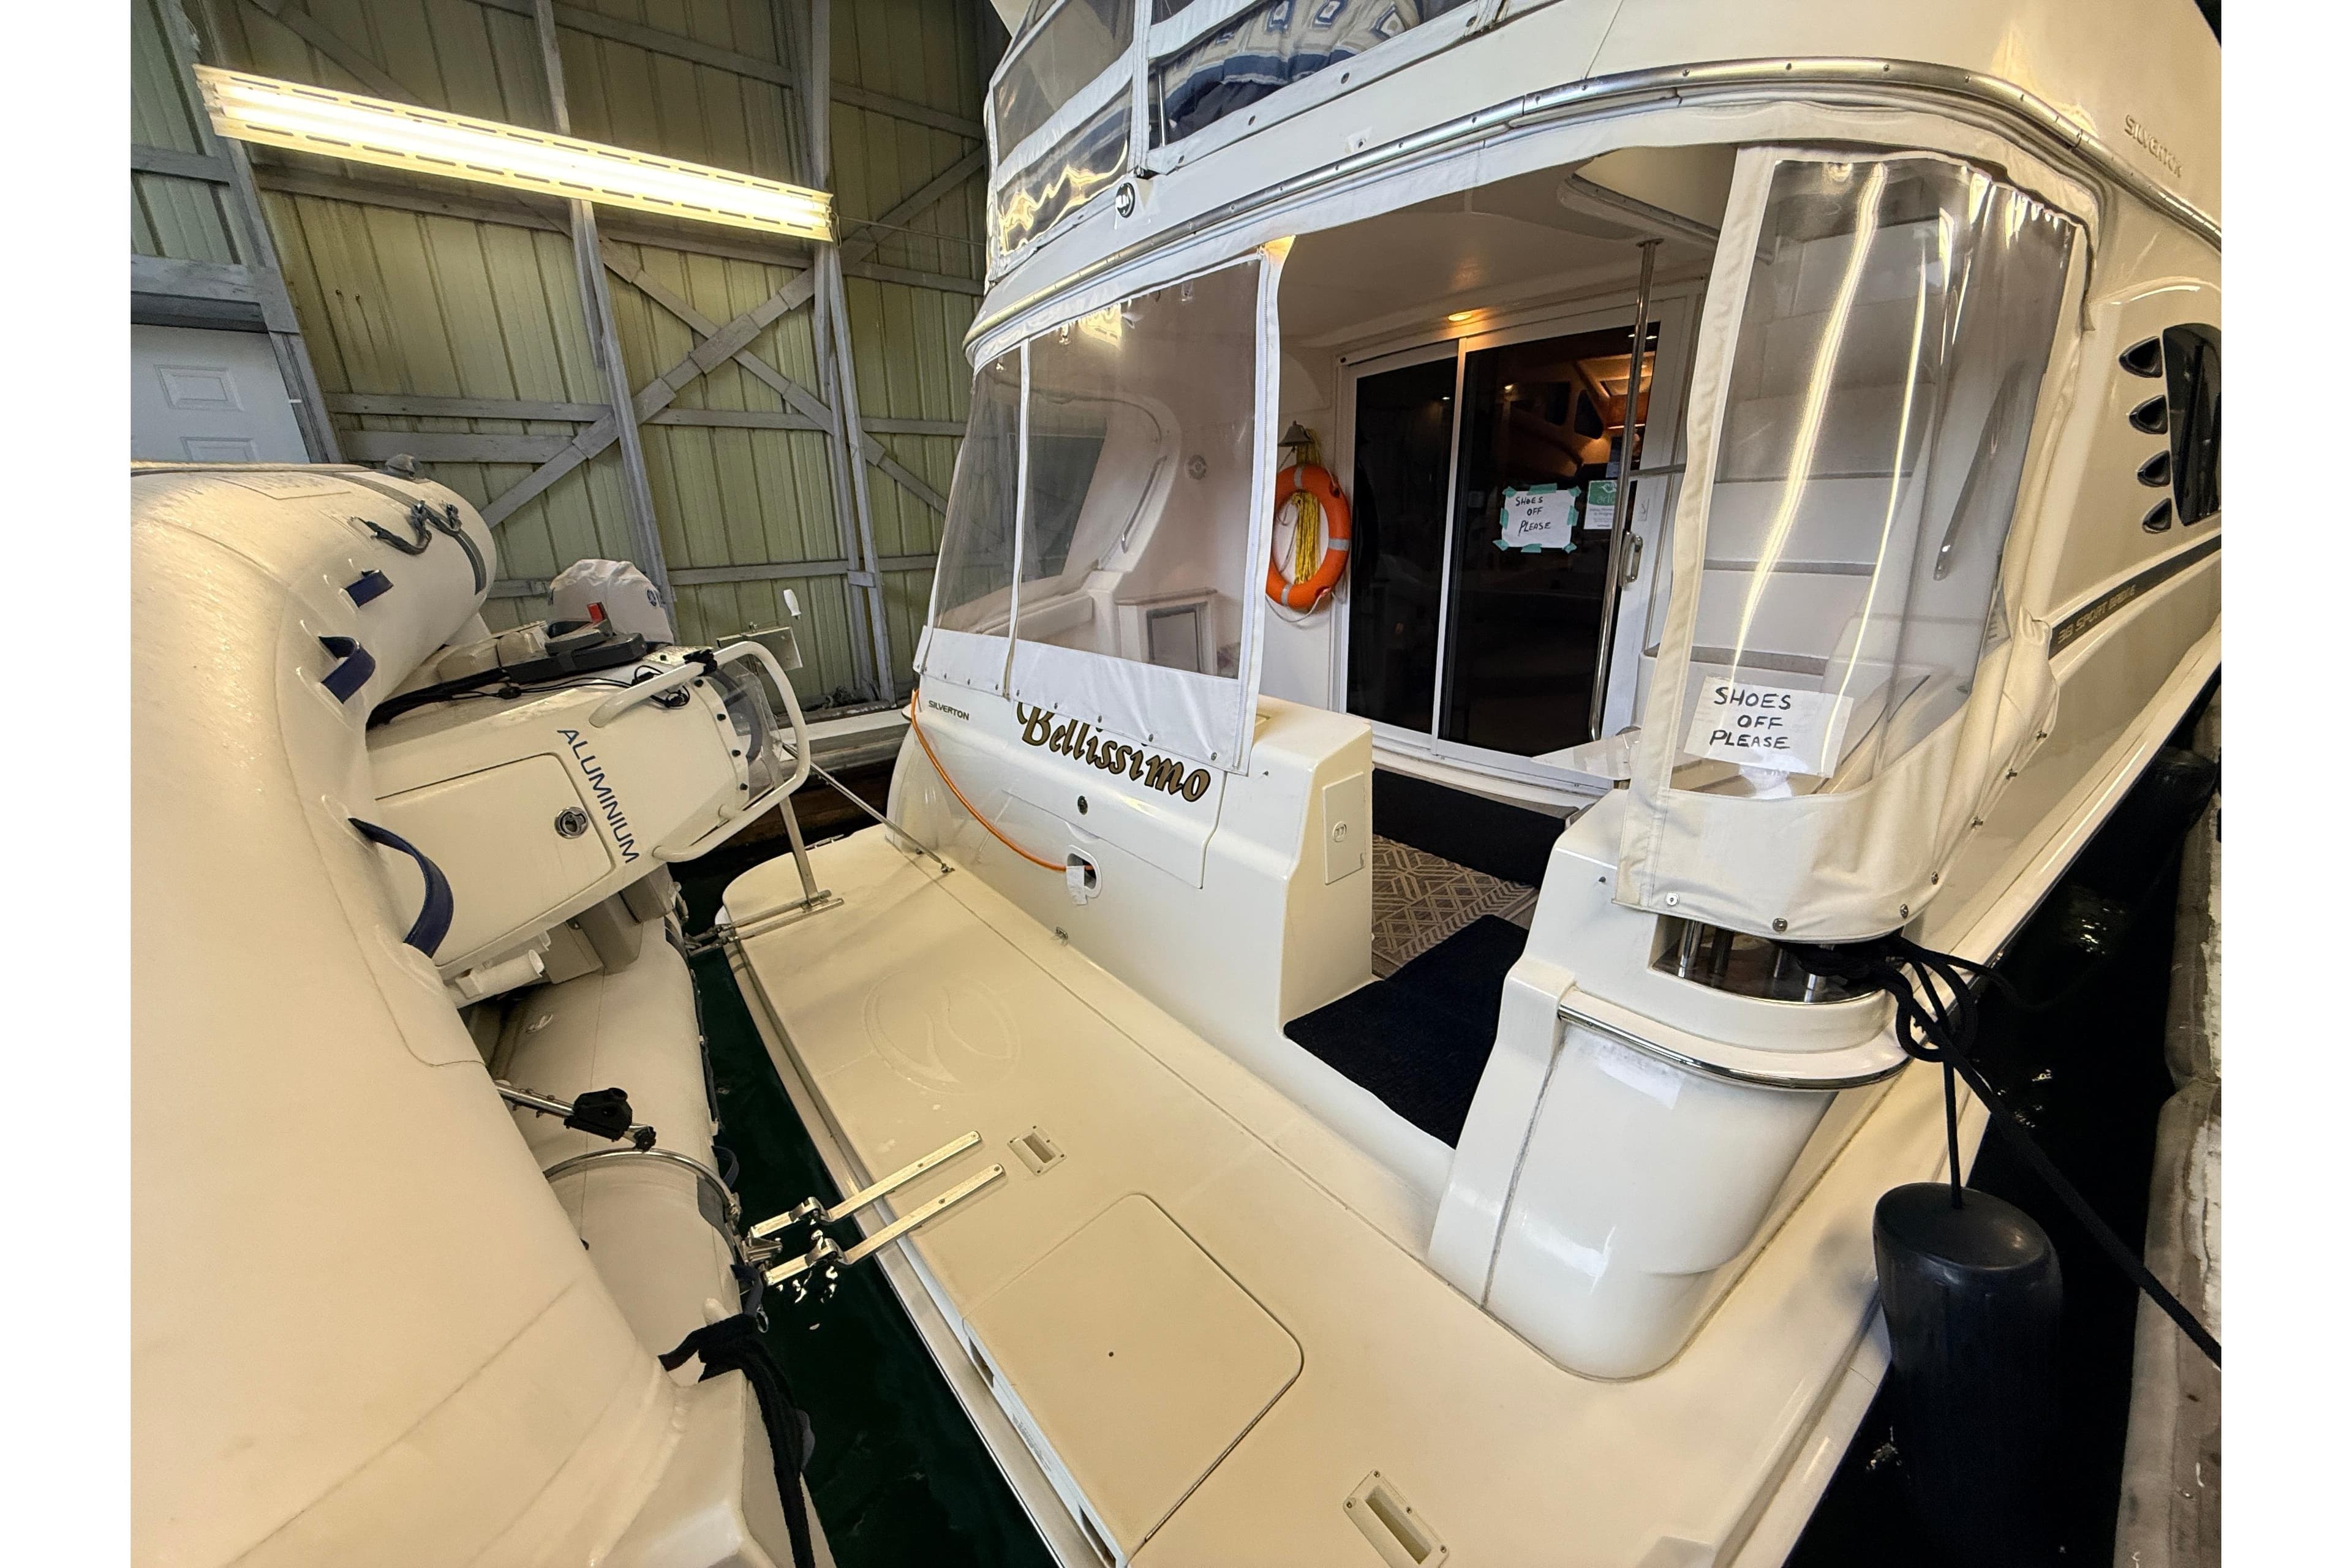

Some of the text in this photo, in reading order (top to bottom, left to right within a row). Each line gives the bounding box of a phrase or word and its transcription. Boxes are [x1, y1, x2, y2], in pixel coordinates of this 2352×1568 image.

[1515, 496, 1544, 507] SHOES
[1517, 520, 1551, 537] PLEASE
[1713, 687, 1792, 710] SHOES
[928, 699, 970, 721] SILVERTON
[1737, 715, 1784, 730] OFF
[1709, 729, 1790, 750] PLEASE
[1016, 701, 1212, 803] Bellissimo
[556, 729, 640, 864] ALUMINIUM
